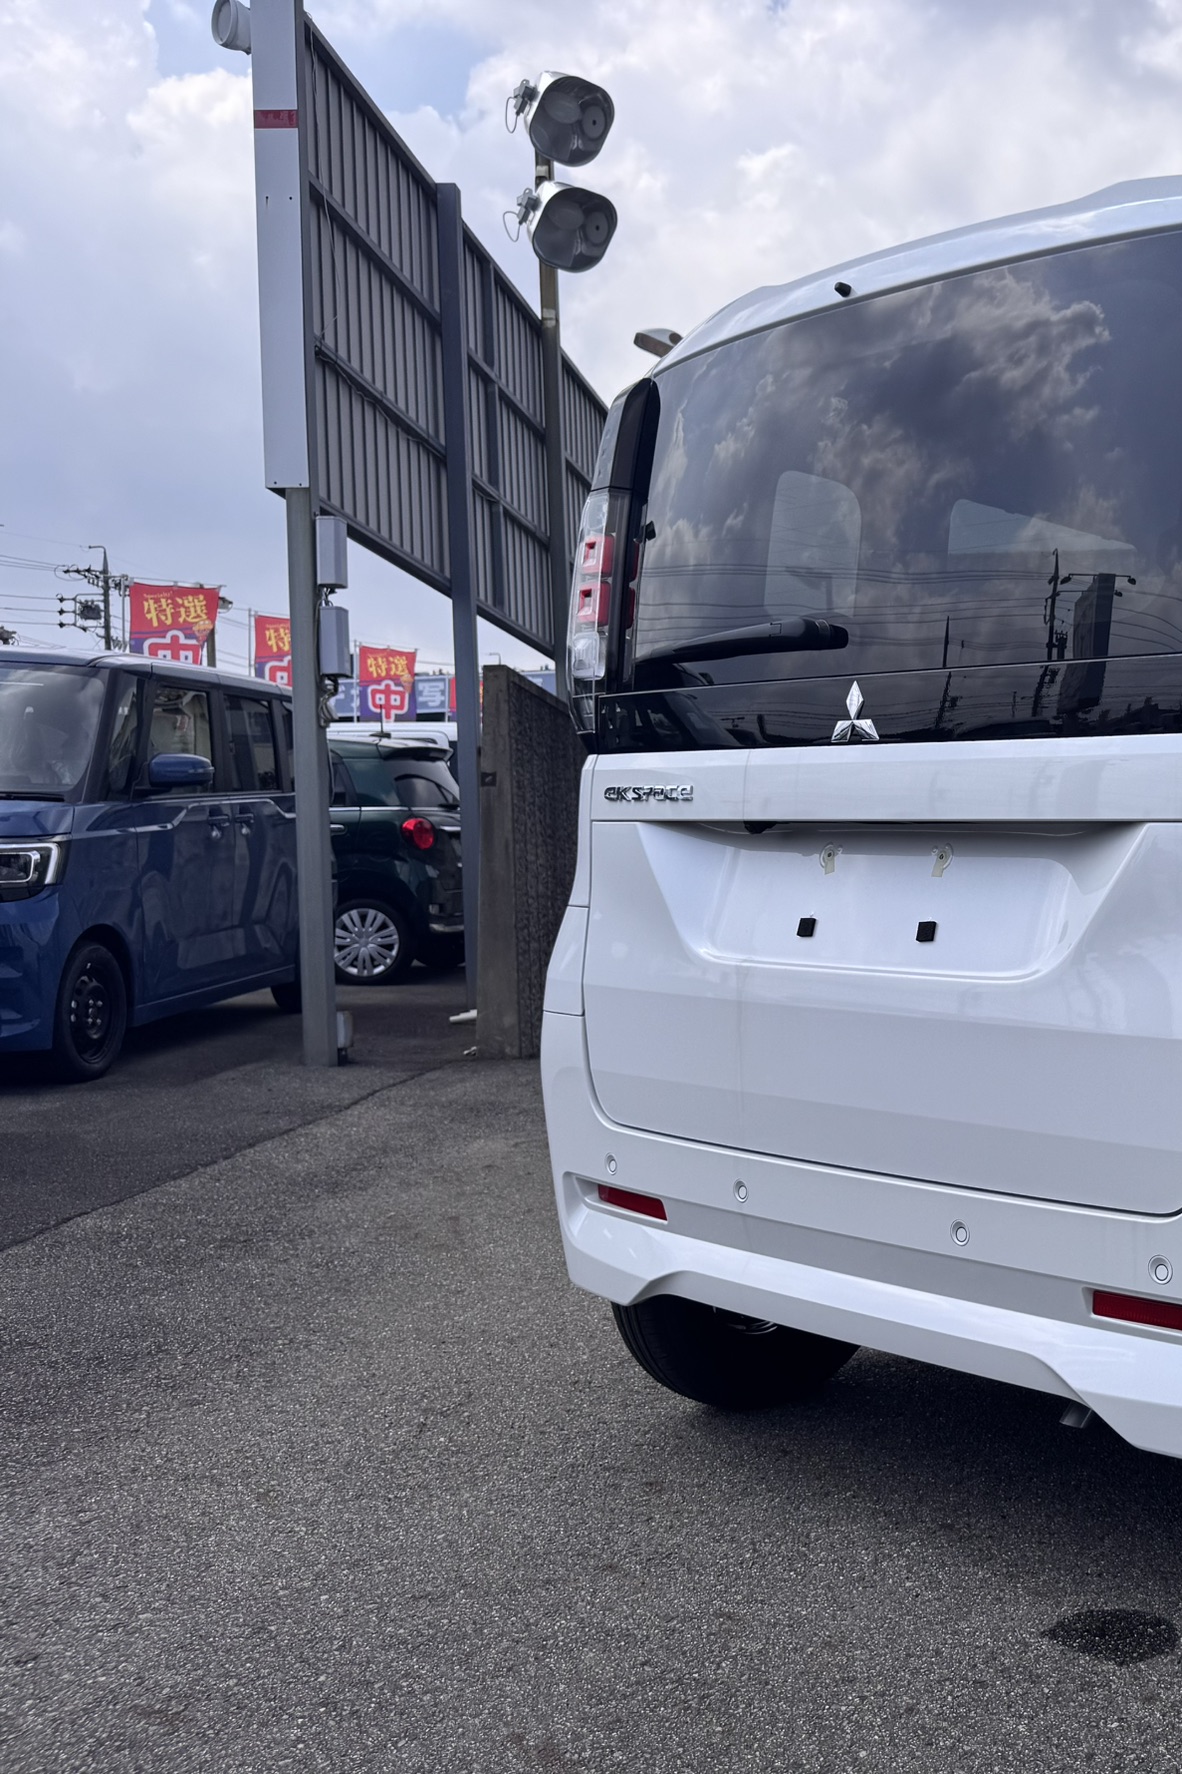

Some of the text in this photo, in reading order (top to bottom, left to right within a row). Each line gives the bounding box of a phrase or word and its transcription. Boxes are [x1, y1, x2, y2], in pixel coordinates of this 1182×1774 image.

[143, 595, 208, 627] 特選
[367, 655, 409, 678] 特選
[369, 681, 408, 721] 中
